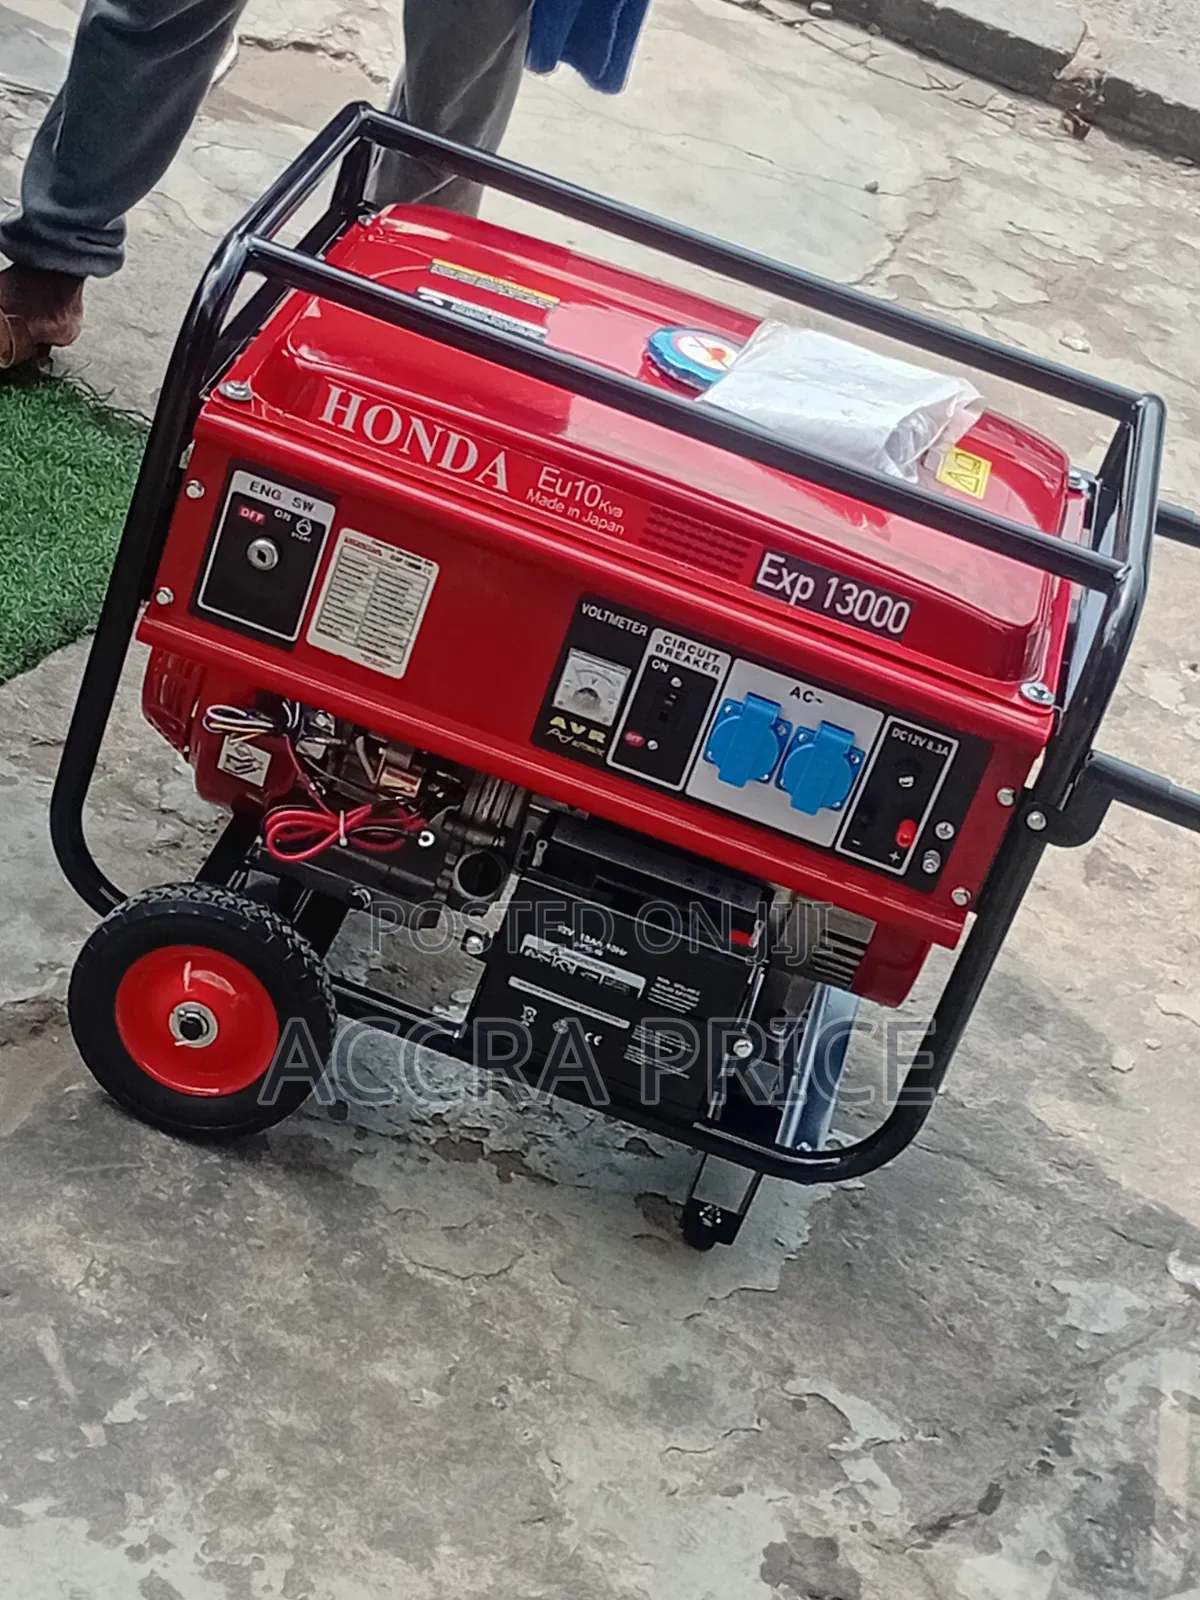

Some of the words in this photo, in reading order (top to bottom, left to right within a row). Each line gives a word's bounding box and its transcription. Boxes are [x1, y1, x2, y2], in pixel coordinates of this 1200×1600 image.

[318, 384, 509, 493] HONDA
[249, 481, 282, 502] ENG
[292, 496, 316, 513] SW
[526, 488, 565, 514] Made
[568, 505, 580, 518] in
[582, 510, 625, 536] Japan
[240, 507, 264, 524] OFF
[274, 508, 291, 522] ON
[756, 551, 815, 606] Exp
[822, 576, 911, 635] 13000
[580, 602, 649, 637] VOLTMETER
[655, 643, 722, 676] BREAKER
[662, 635, 721, 663] CIRCUIT
[651, 658, 670, 674] ON
[549, 716, 607, 744] AVR
[891, 727, 927, 748] DC12V
